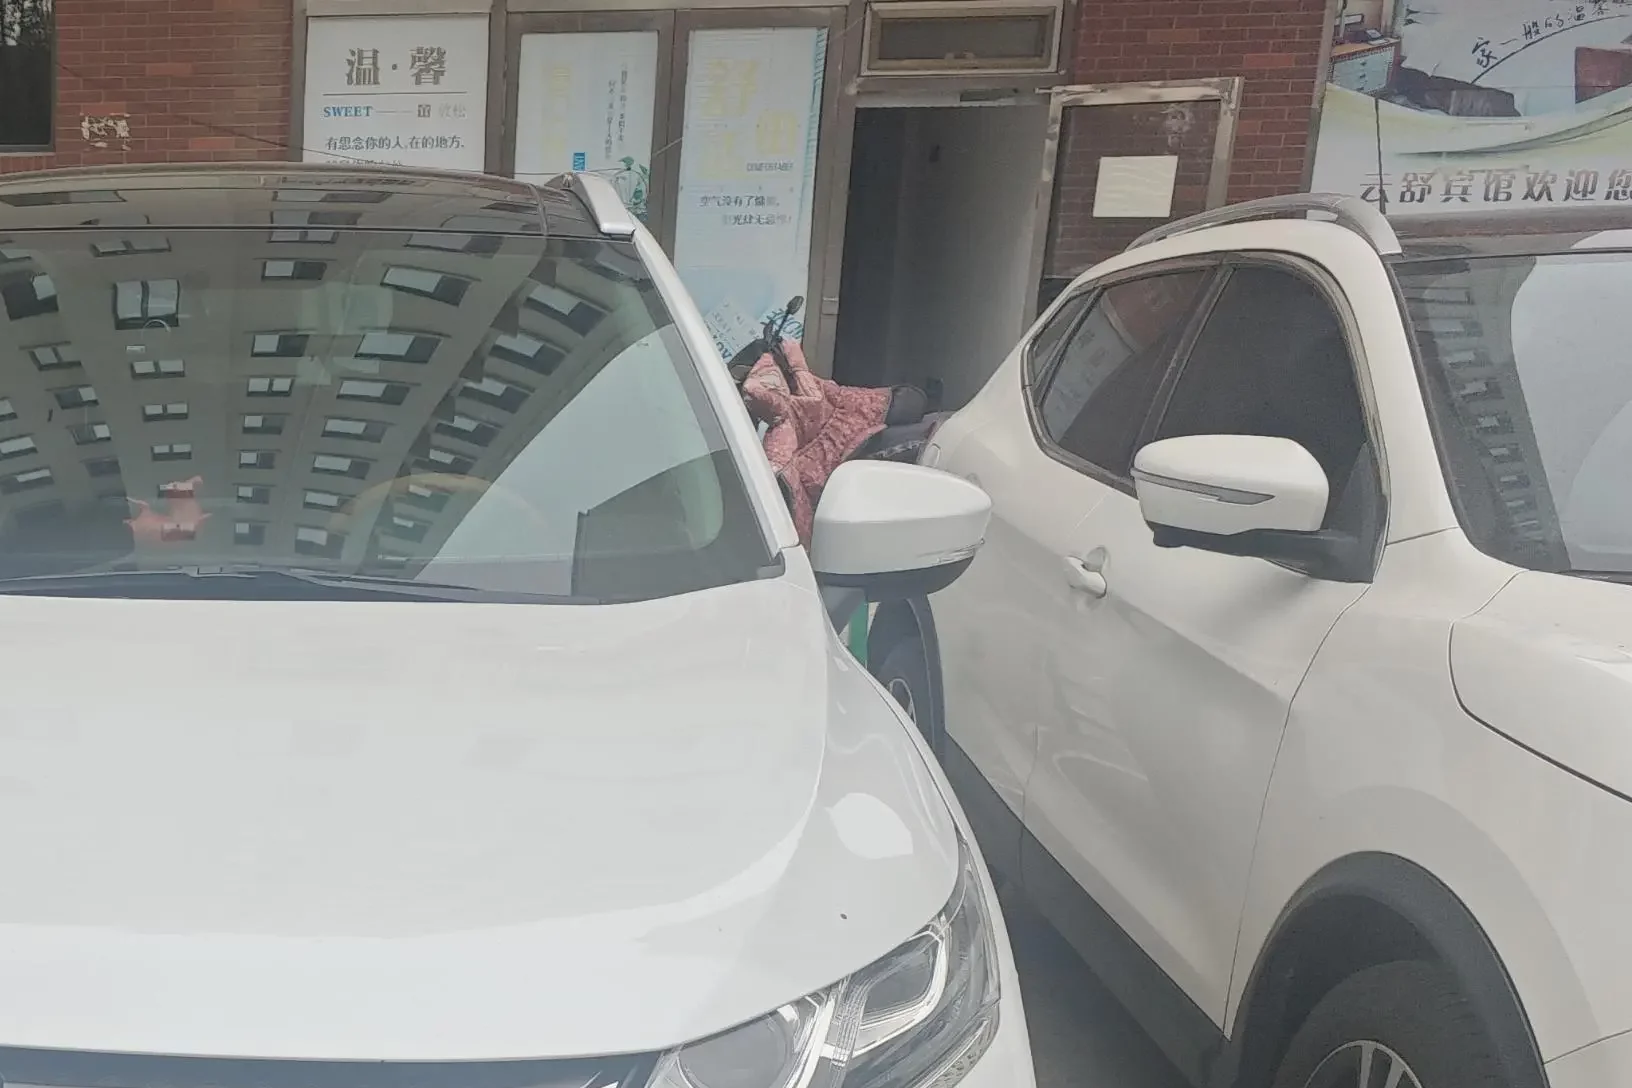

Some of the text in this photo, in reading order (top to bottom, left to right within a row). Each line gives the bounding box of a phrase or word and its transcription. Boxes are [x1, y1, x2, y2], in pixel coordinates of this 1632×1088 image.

[323, 105, 374, 118] SWEET
[1360, 168, 1632, 204] 云舒宾馆欢迎您
